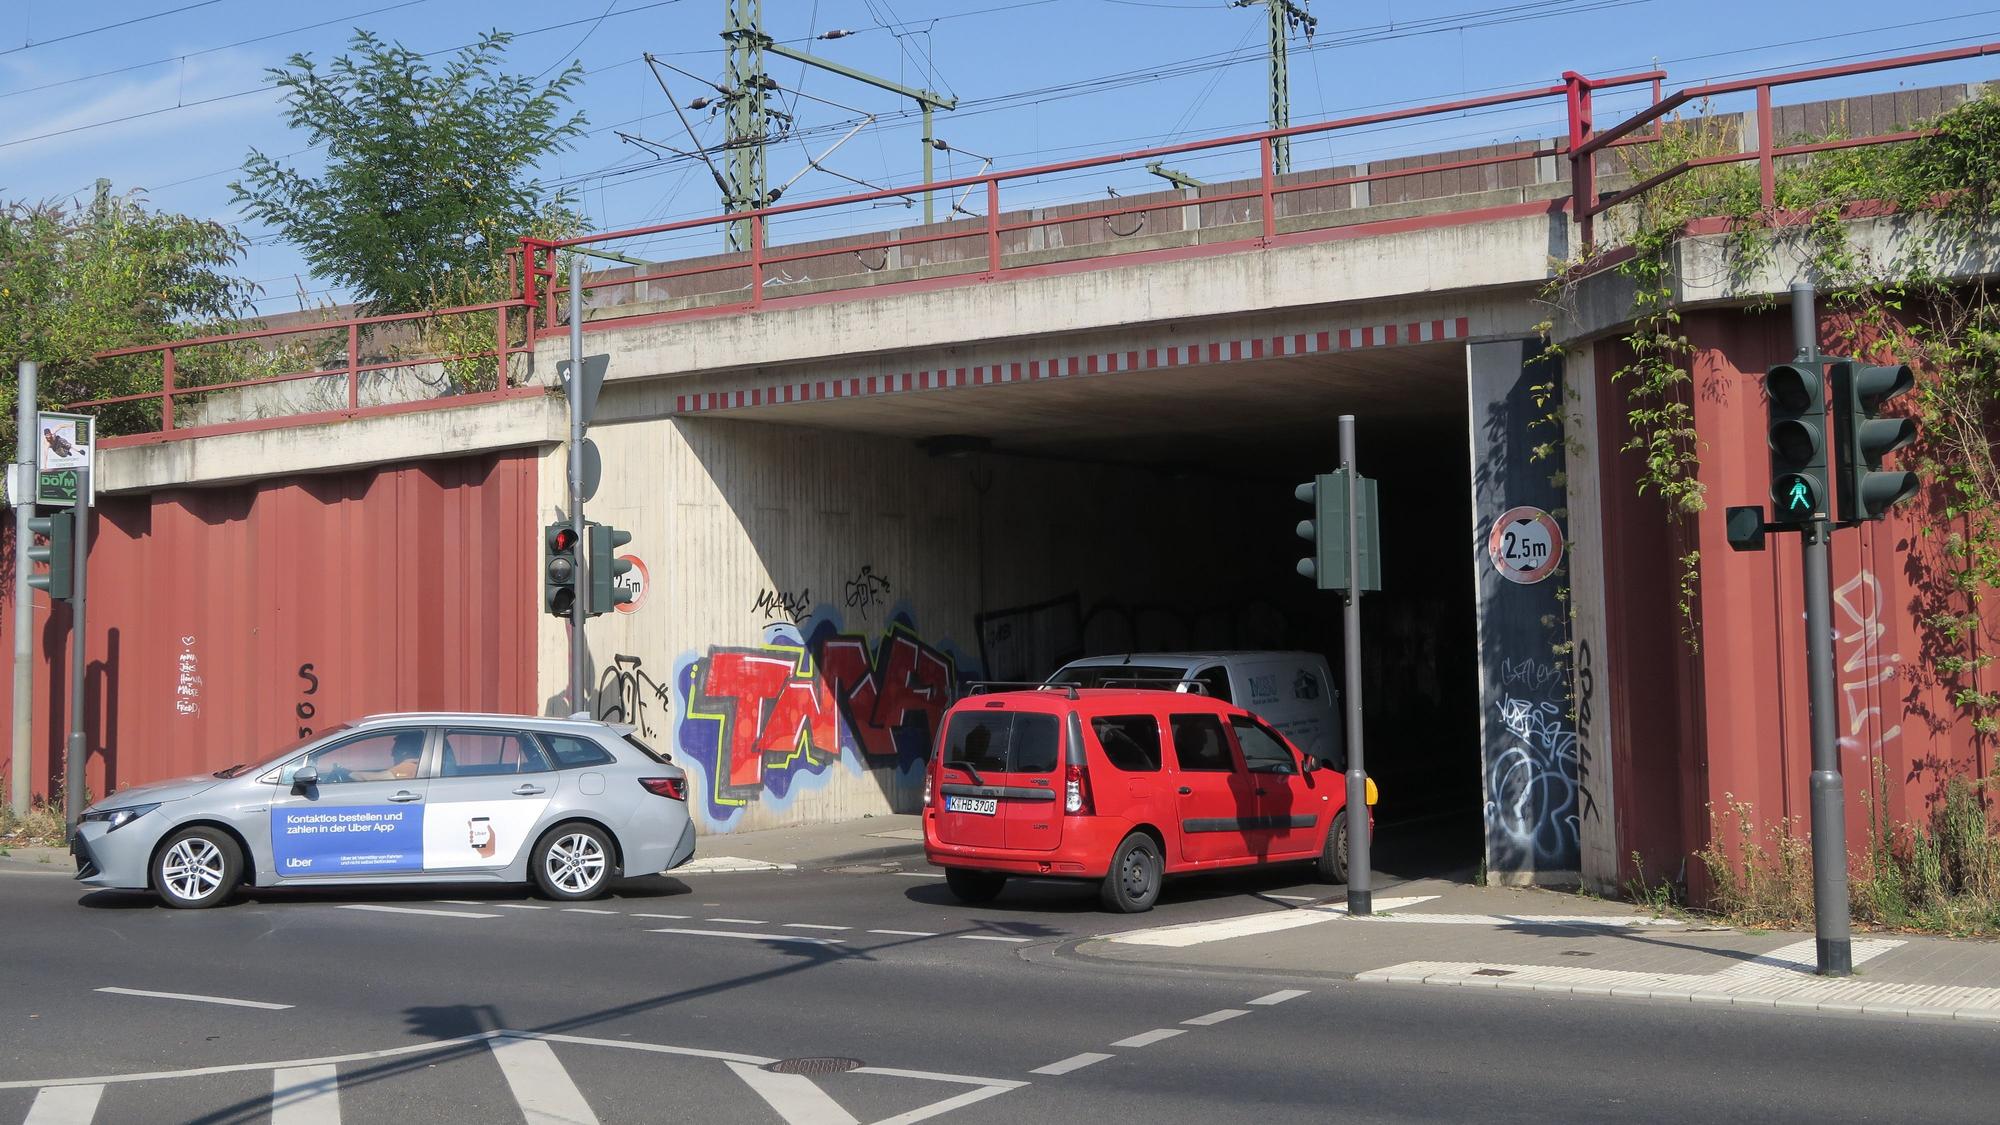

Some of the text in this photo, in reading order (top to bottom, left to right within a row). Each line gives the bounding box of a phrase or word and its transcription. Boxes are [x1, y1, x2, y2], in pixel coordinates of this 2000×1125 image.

[961, 799, 973, 811] HB
[974, 800, 995, 812] 3708
[287, 812, 403, 824] Kontaktlos bestellen und
[287, 823, 395, 834] zahlen in der Uber App
[286, 858, 313, 868] Uber
